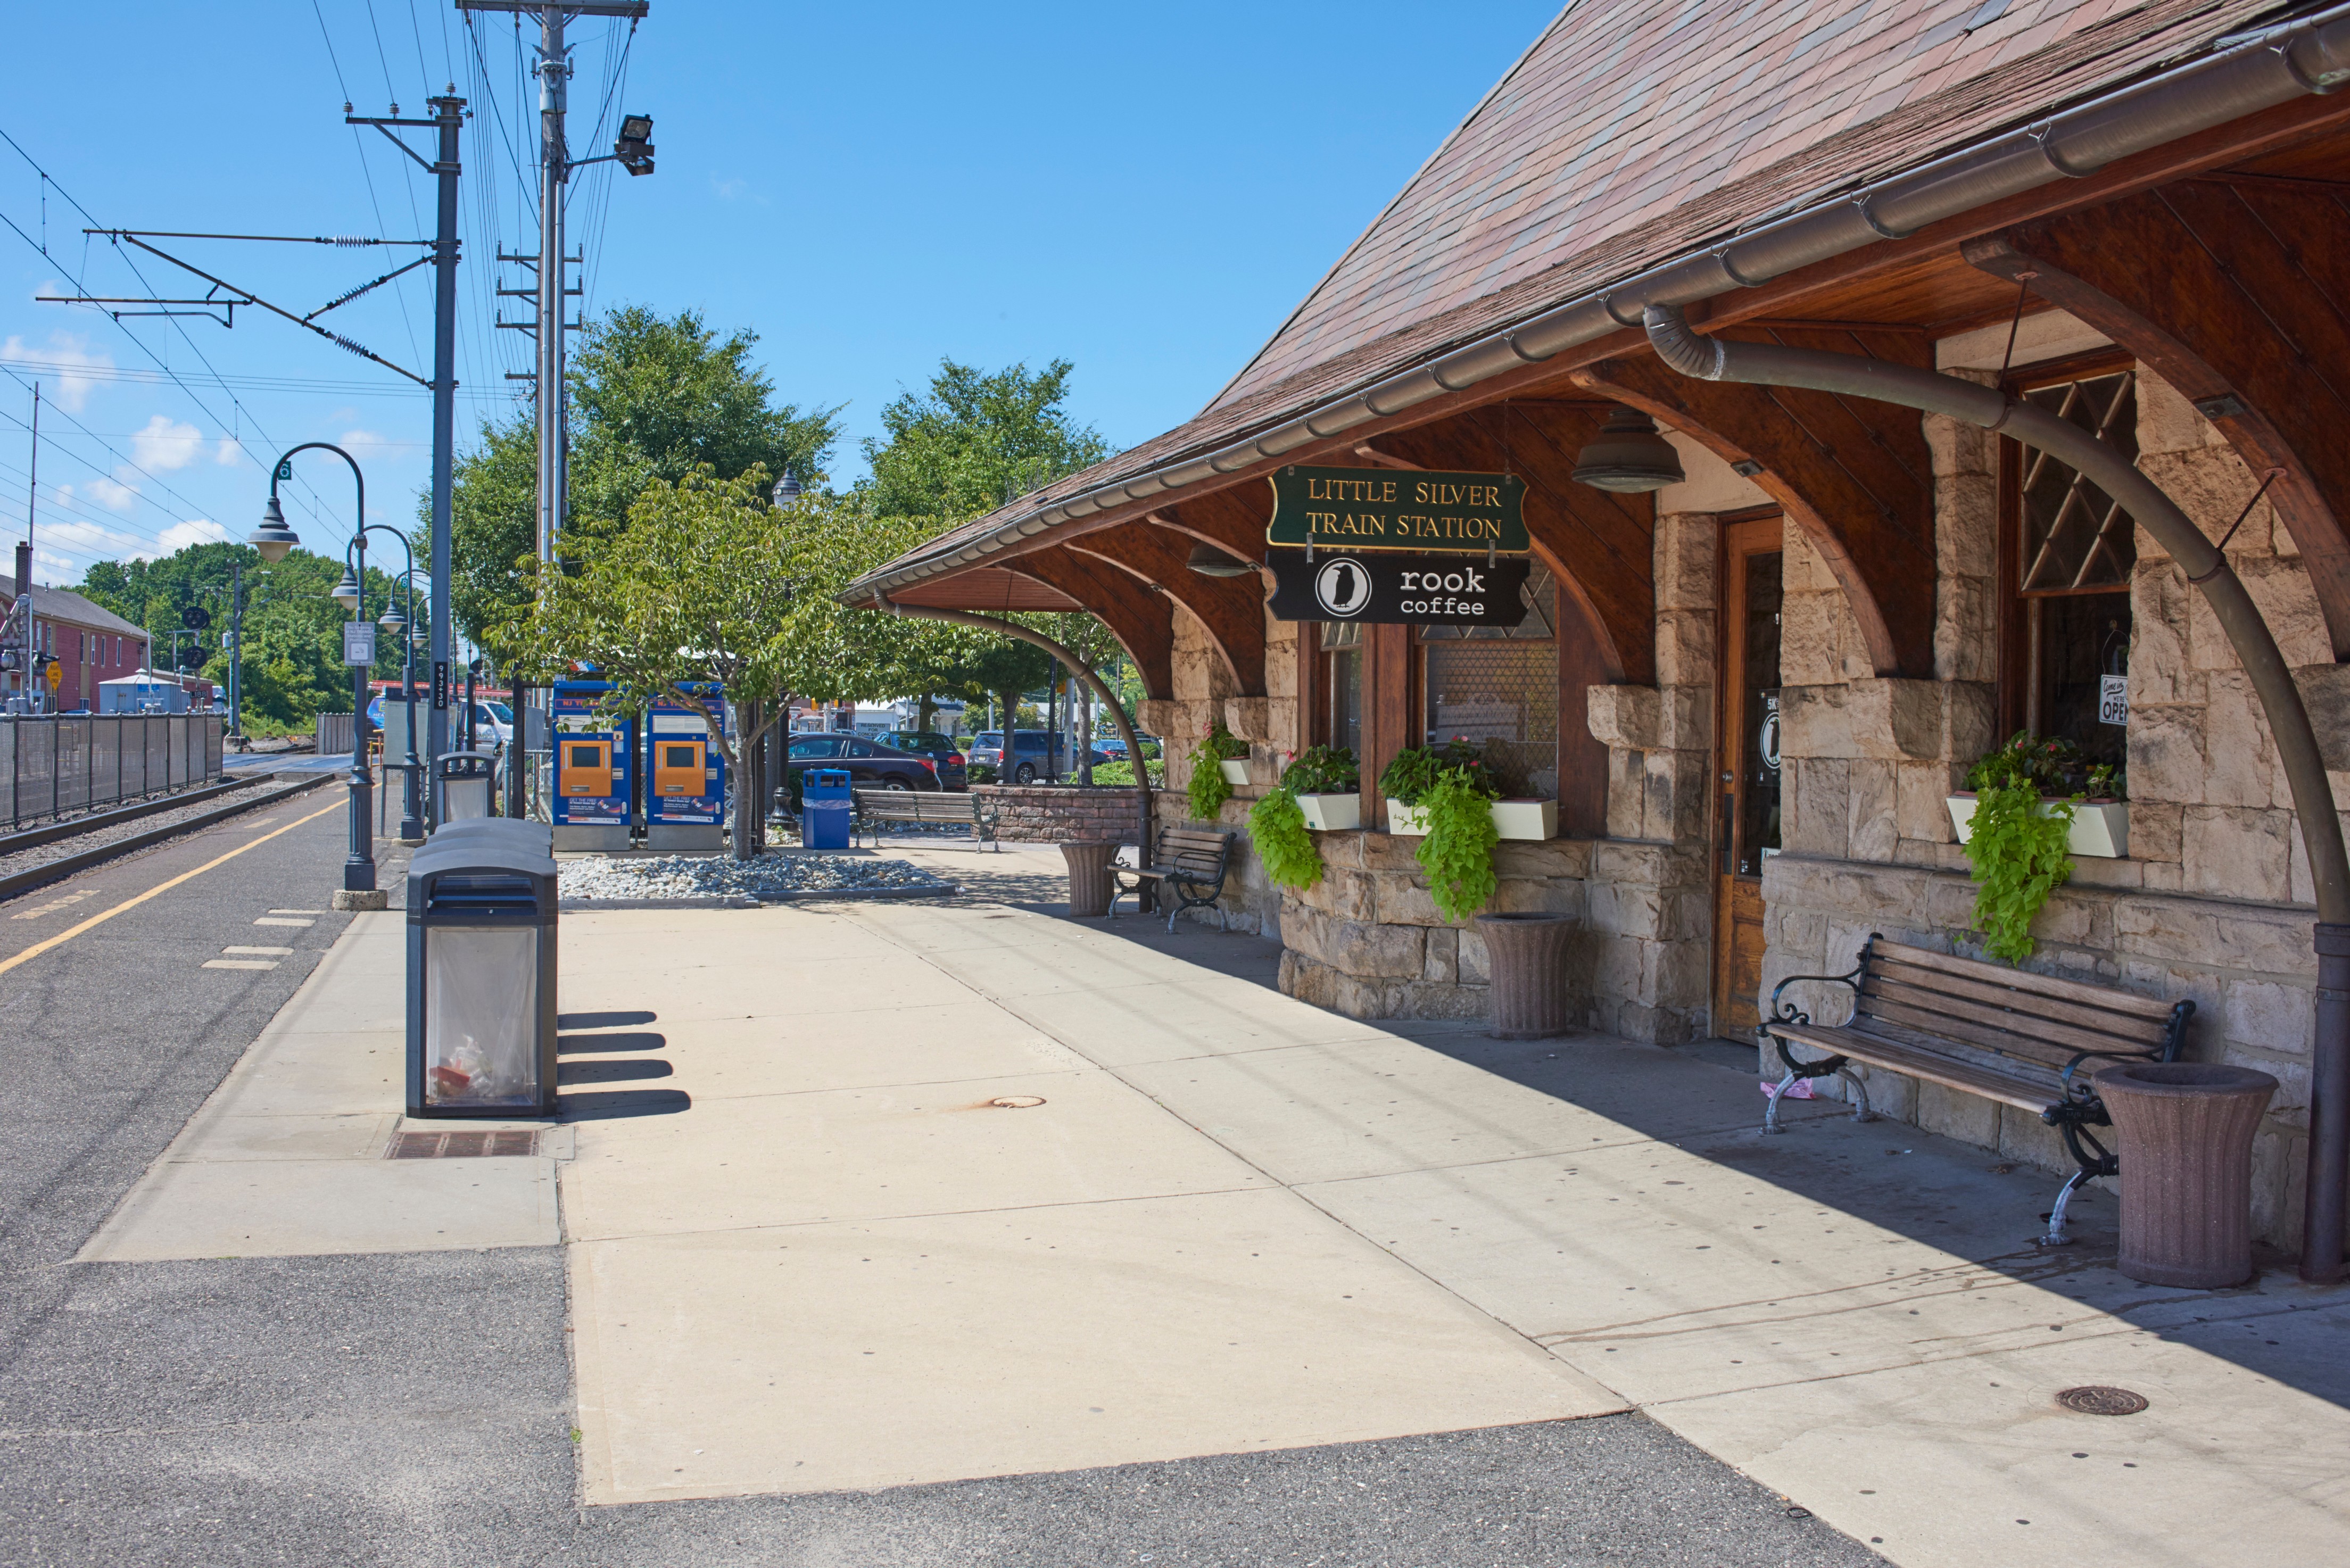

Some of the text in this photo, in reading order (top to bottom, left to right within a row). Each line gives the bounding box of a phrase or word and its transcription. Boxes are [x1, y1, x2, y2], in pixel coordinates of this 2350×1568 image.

[1308, 478, 1502, 507] LITTLE SILVER
[1306, 512, 1502, 540] TRAIN STATION
[1400, 567, 1486, 593] rook
[1401, 597, 1485, 615] coffee
[2103, 680, 2116, 692] Come
[1768, 698, 1777, 710] 5K
